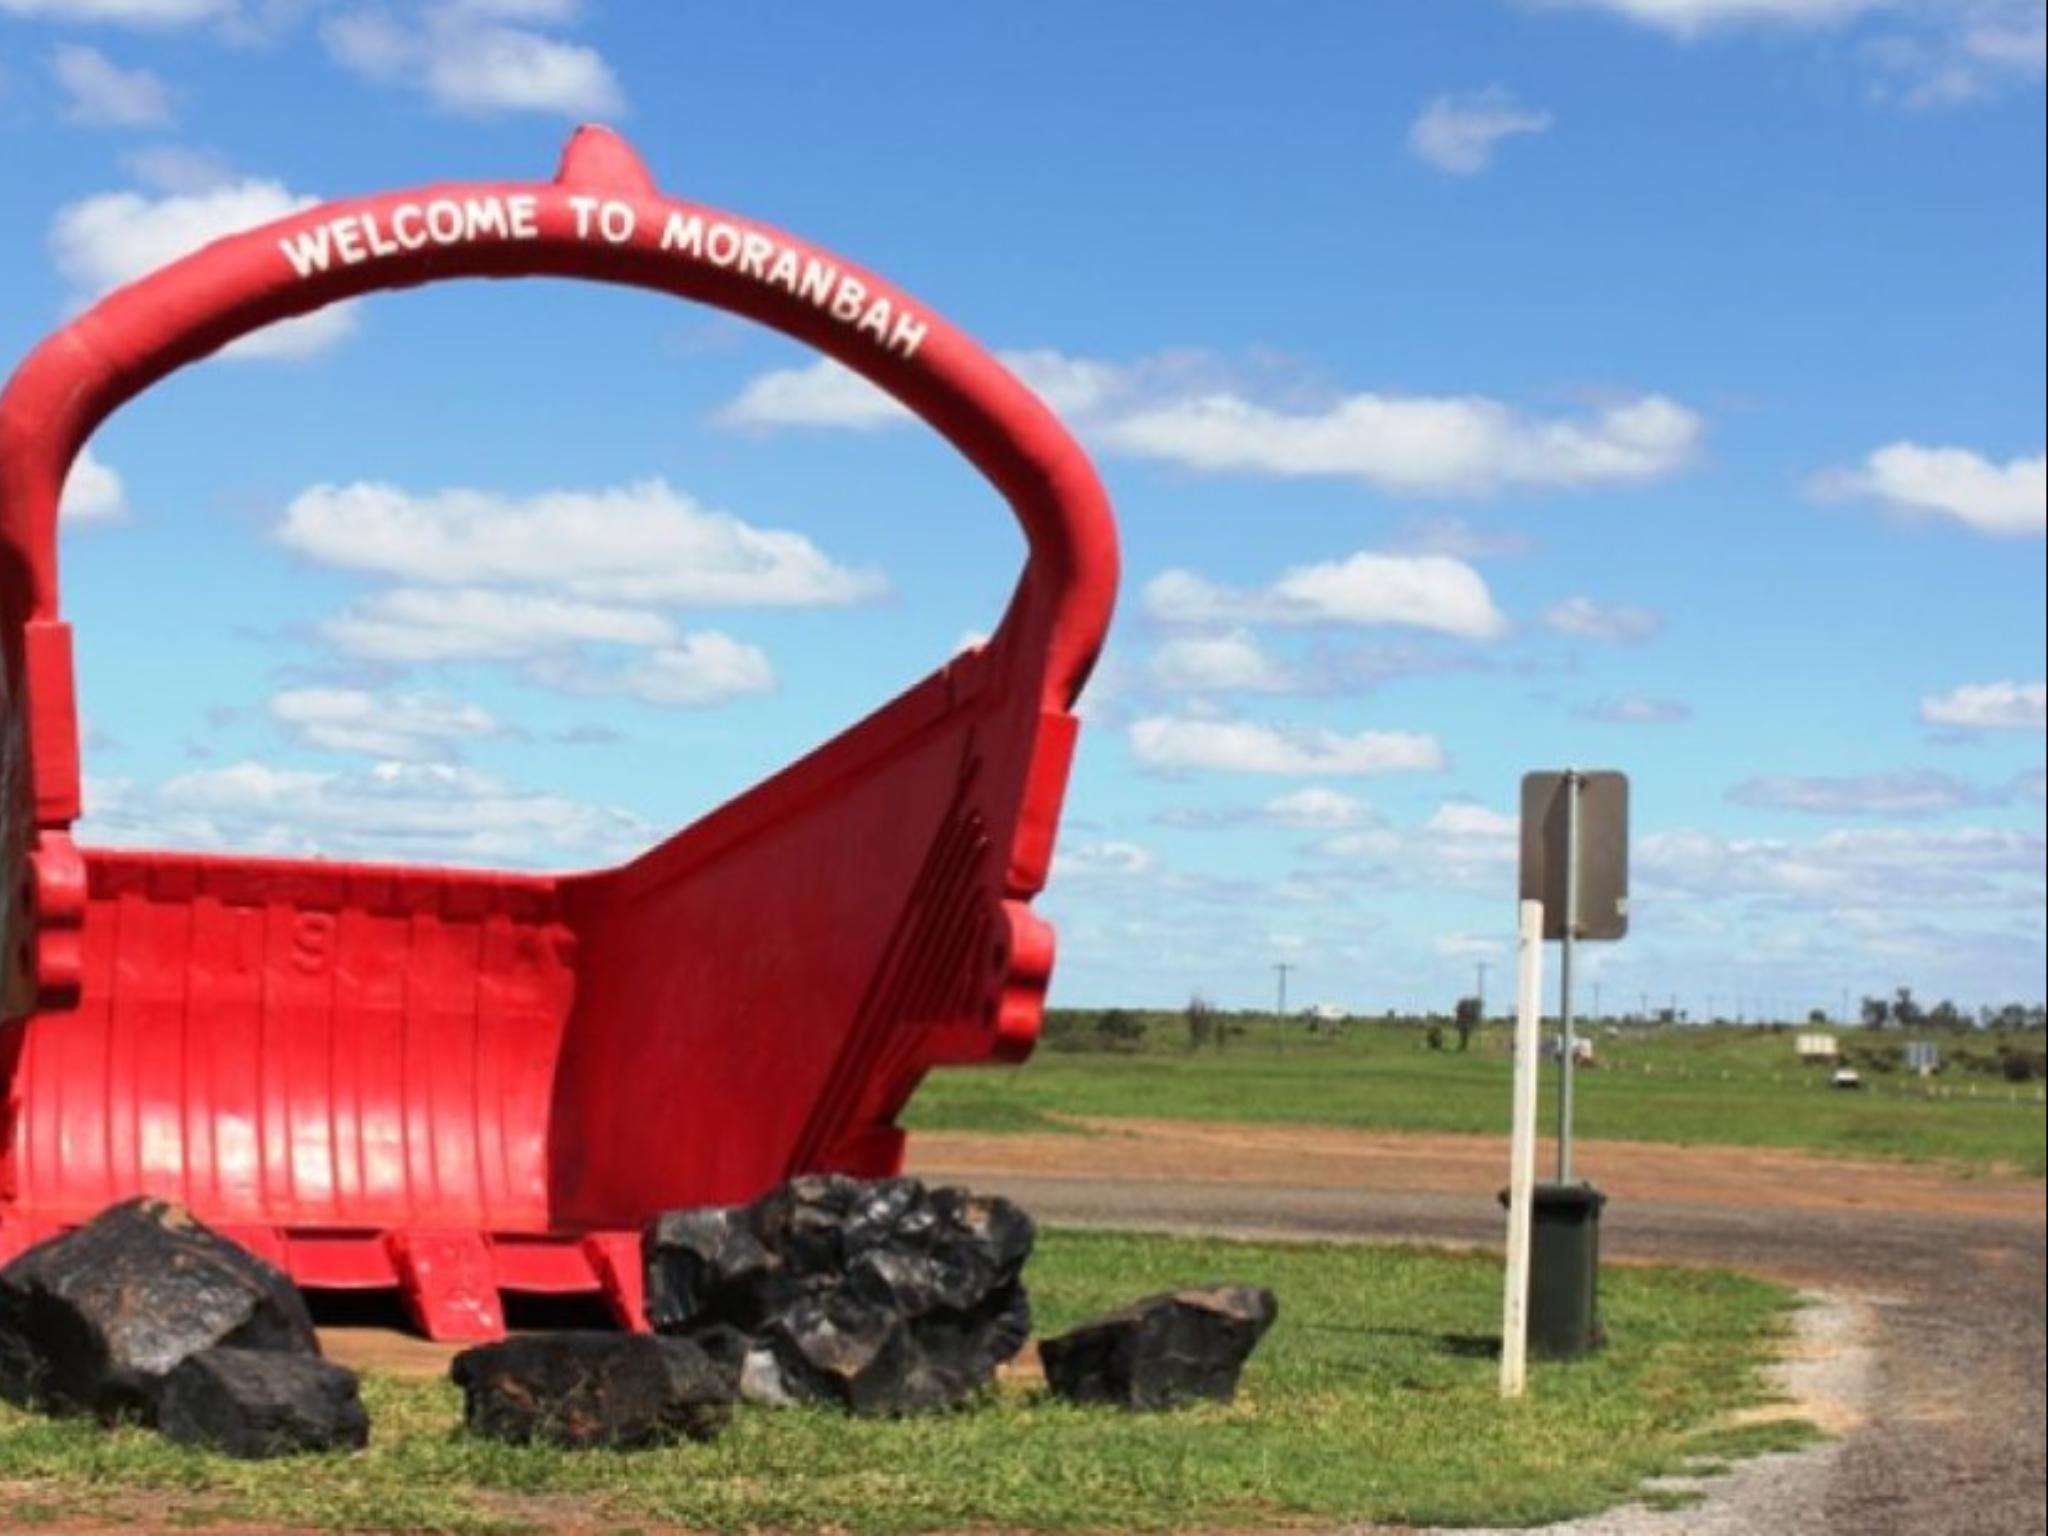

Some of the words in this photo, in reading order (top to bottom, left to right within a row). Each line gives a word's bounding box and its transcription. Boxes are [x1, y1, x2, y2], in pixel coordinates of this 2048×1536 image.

[279, 193, 539, 279] WELCOME
[568, 195, 636, 245] TO
[660, 212, 928, 359] MORANBAH
